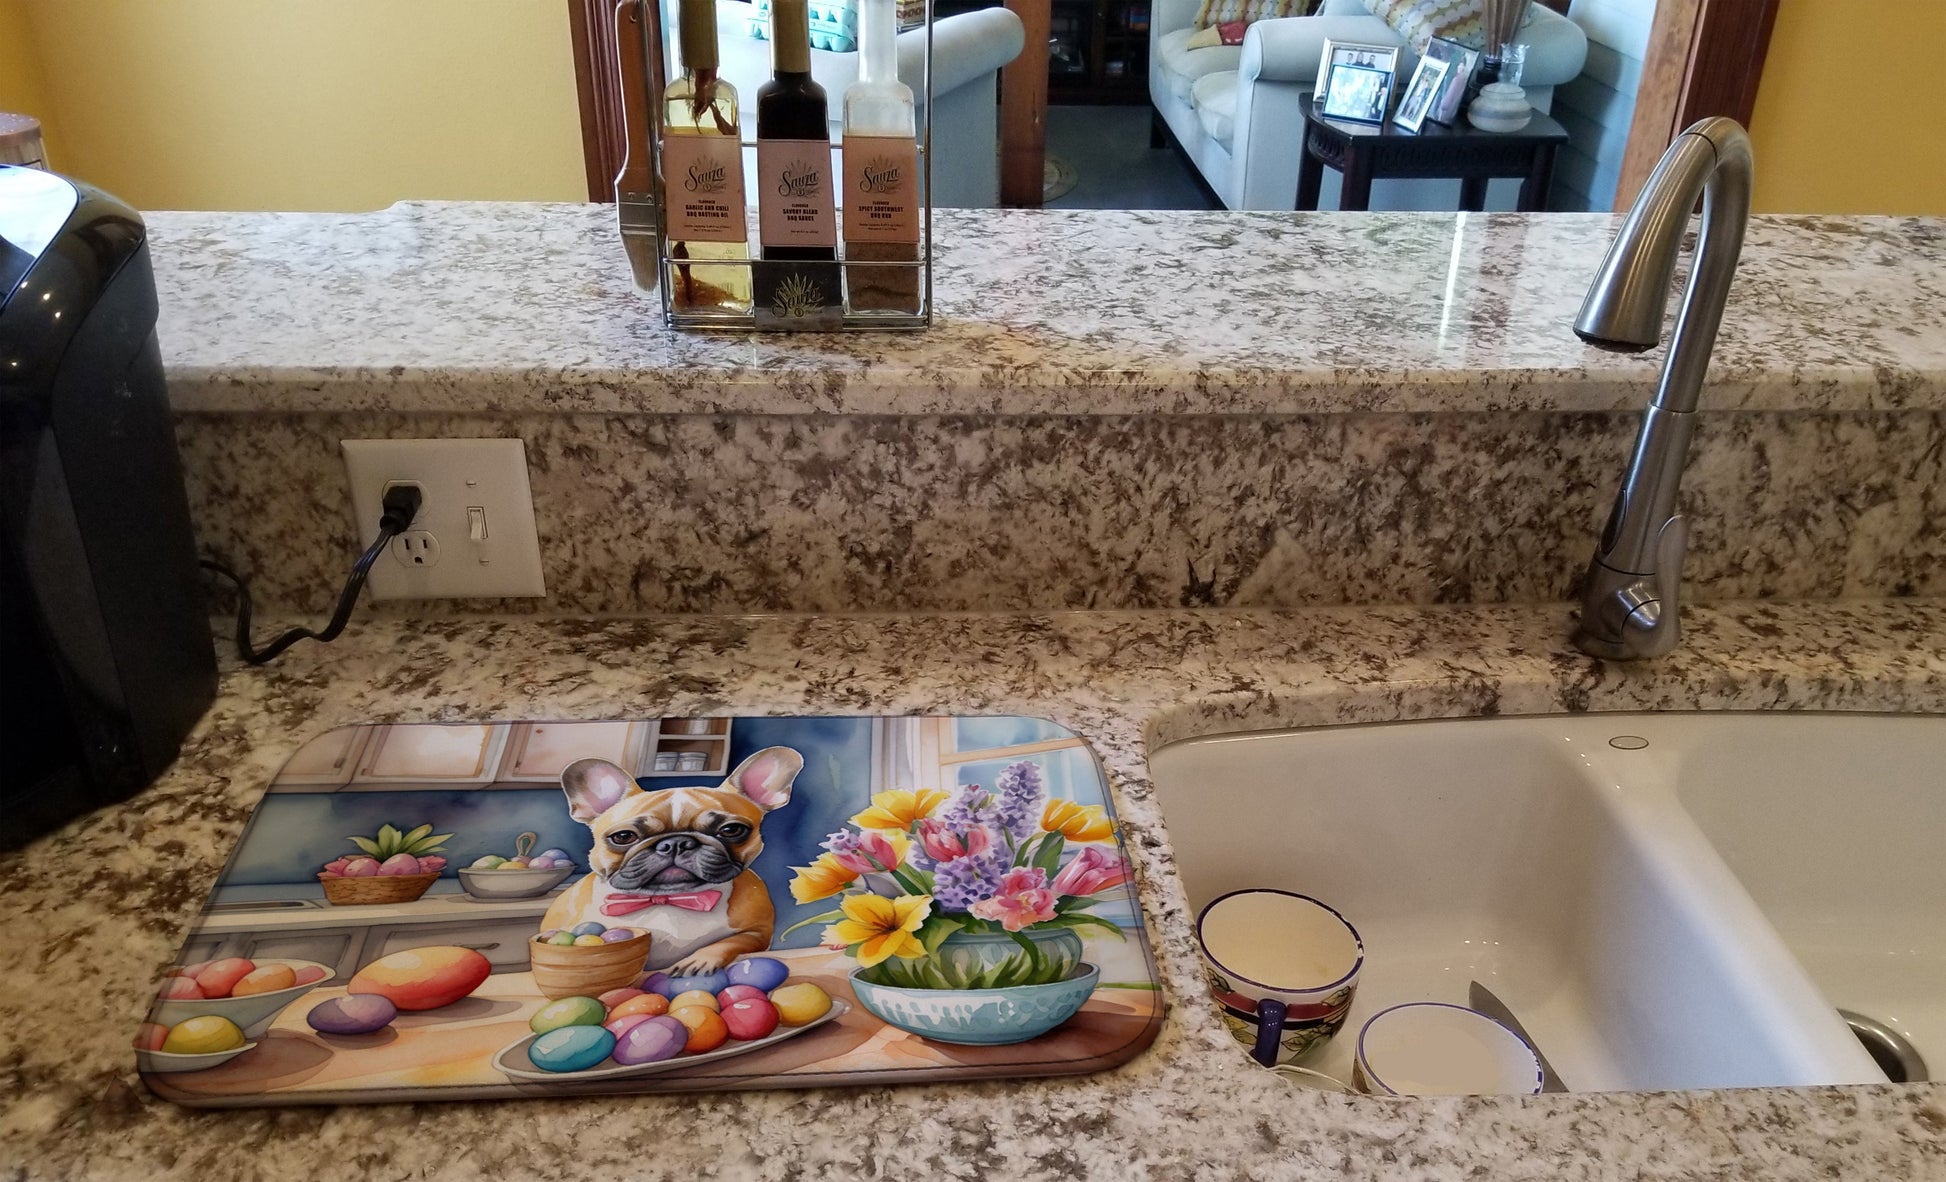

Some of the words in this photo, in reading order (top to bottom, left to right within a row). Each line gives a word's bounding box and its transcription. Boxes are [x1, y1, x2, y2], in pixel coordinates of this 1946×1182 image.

[685, 166, 725, 192] Sauza
[778, 170, 819, 197] Sauza
[860, 166, 901, 192] Sauza
